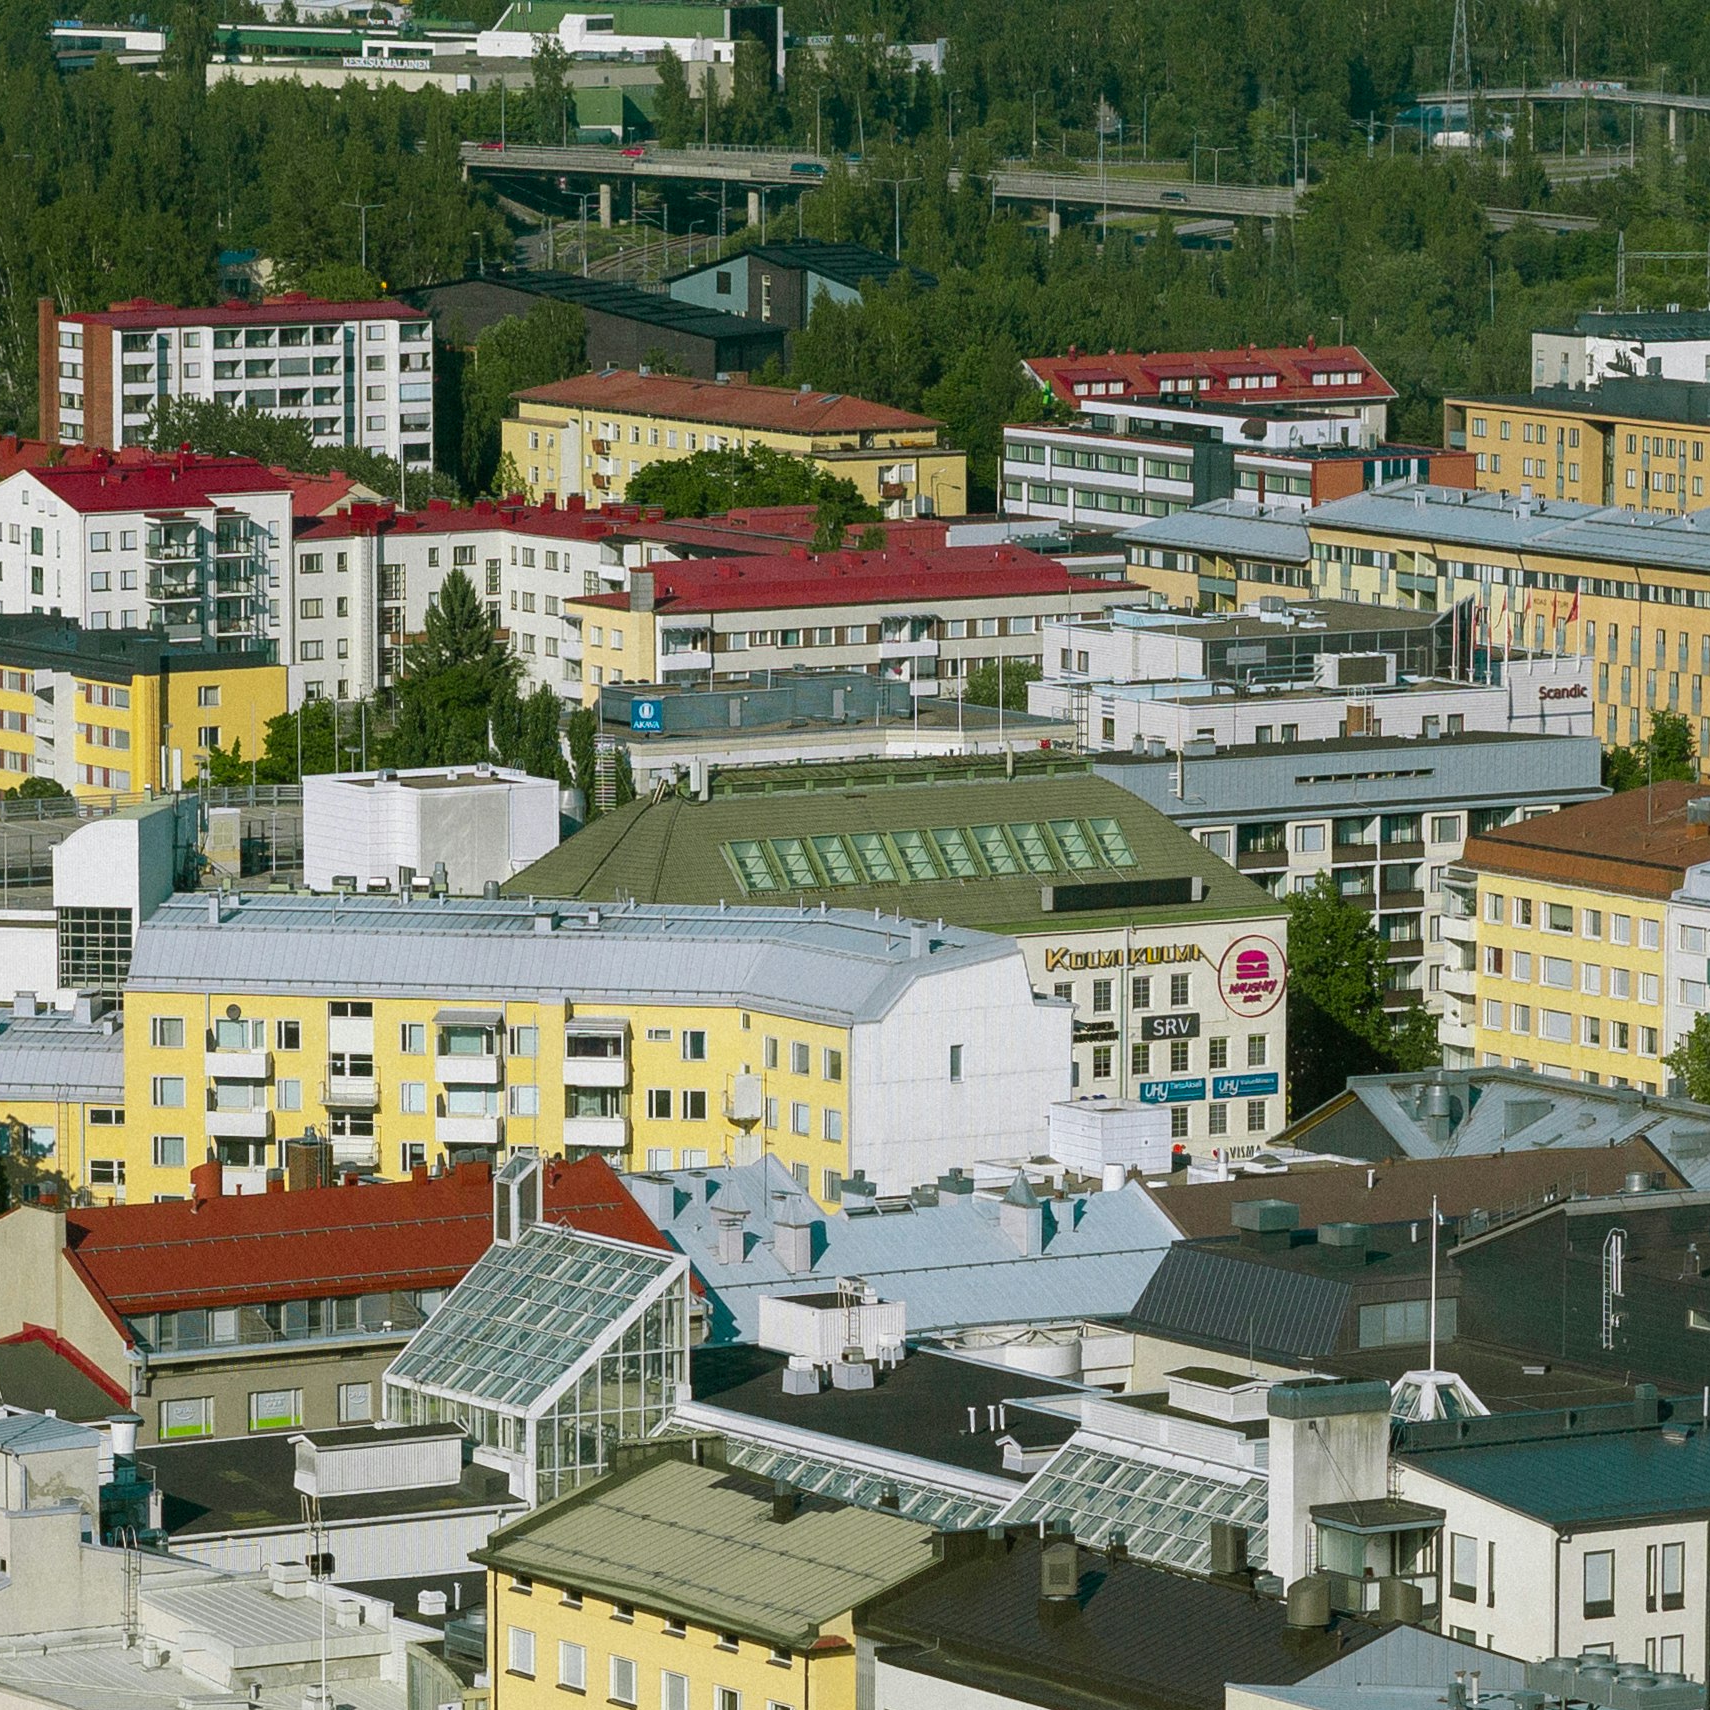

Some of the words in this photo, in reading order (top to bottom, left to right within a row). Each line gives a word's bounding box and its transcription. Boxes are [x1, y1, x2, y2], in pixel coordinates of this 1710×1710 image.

[342, 56, 430, 70] KESKISUOMALAINEN
[1538, 684, 1588, 700] Scandic
[633, 720, 660, 729] AKAVA
[1152, 1017, 1191, 1037] SRV
[1145, 1083, 1169, 1102] UHY
[1218, 1079, 1240, 1096] UHY
